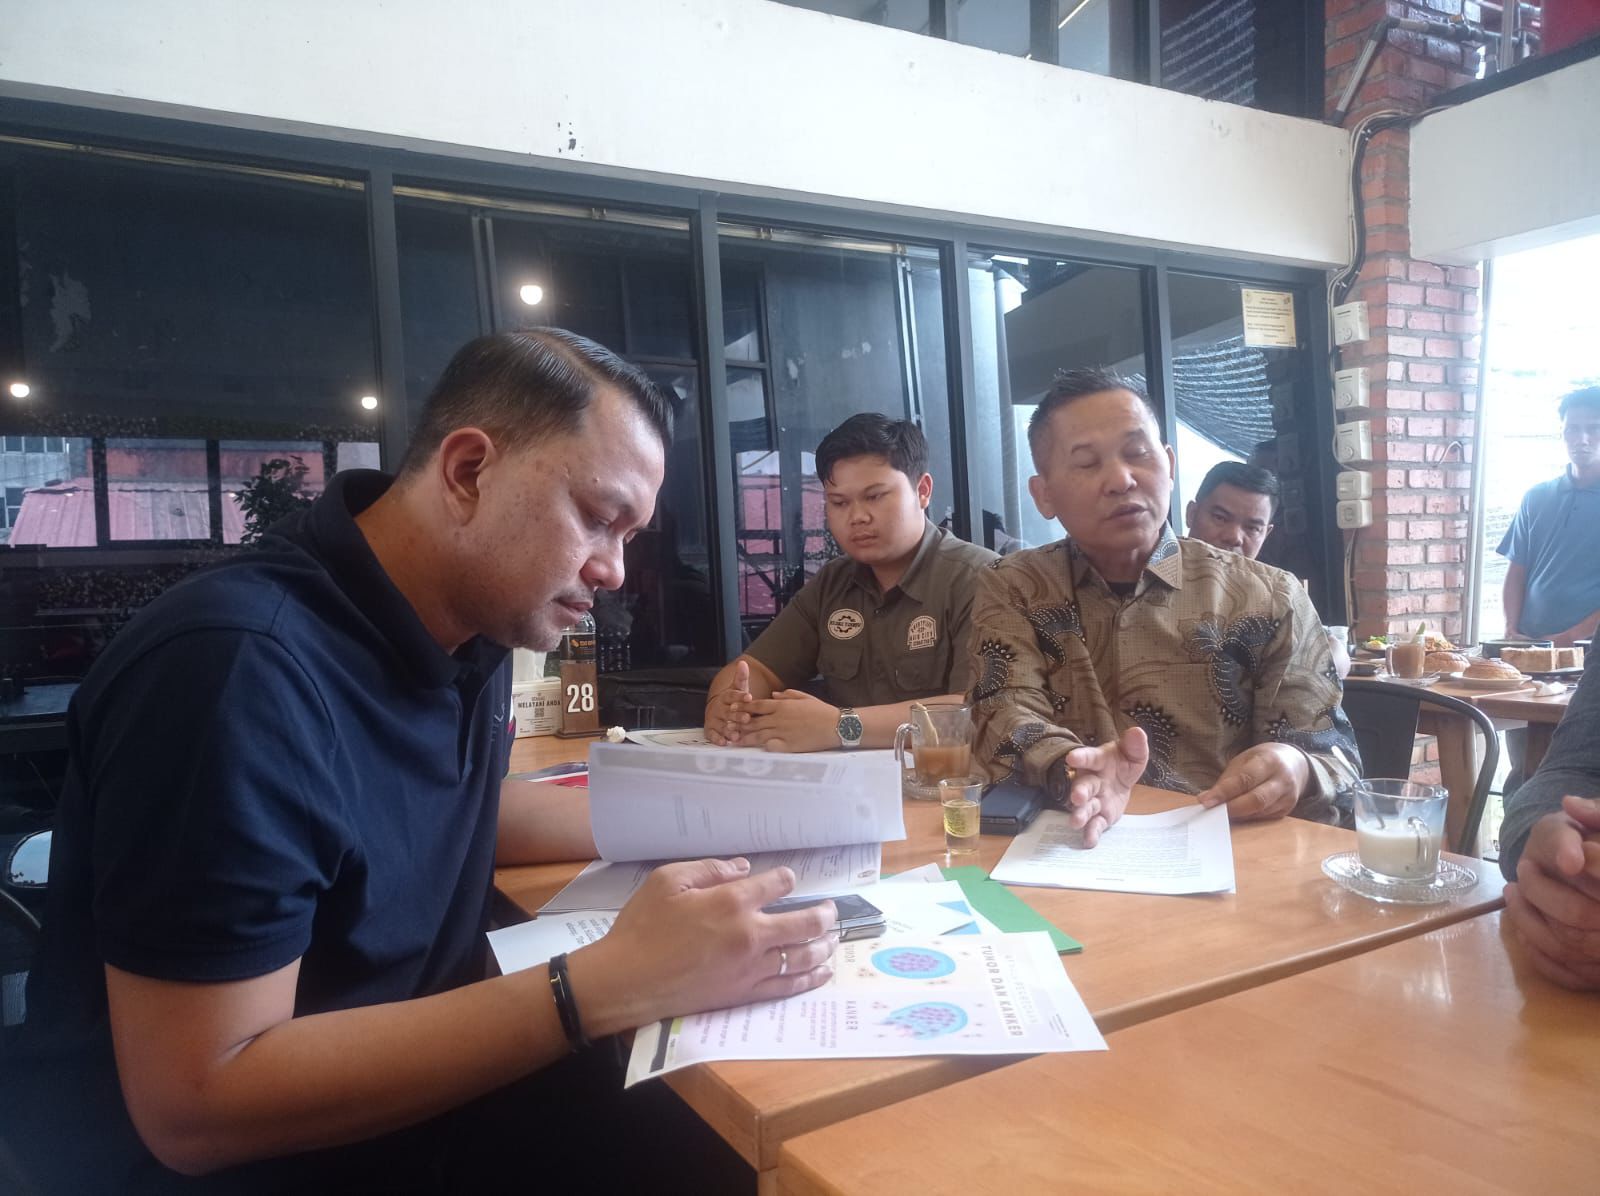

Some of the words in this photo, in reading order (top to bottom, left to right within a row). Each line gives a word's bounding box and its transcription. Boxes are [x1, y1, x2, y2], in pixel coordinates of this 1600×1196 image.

[566, 682, 595, 713] 28
[844, 944, 856, 963] TUMOR
[981, 945, 1001, 974] TUMOR
[991, 977, 1008, 997] DAN
[1000, 1000, 1023, 1036] KANKER
[845, 1000, 858, 1030] KANKER
